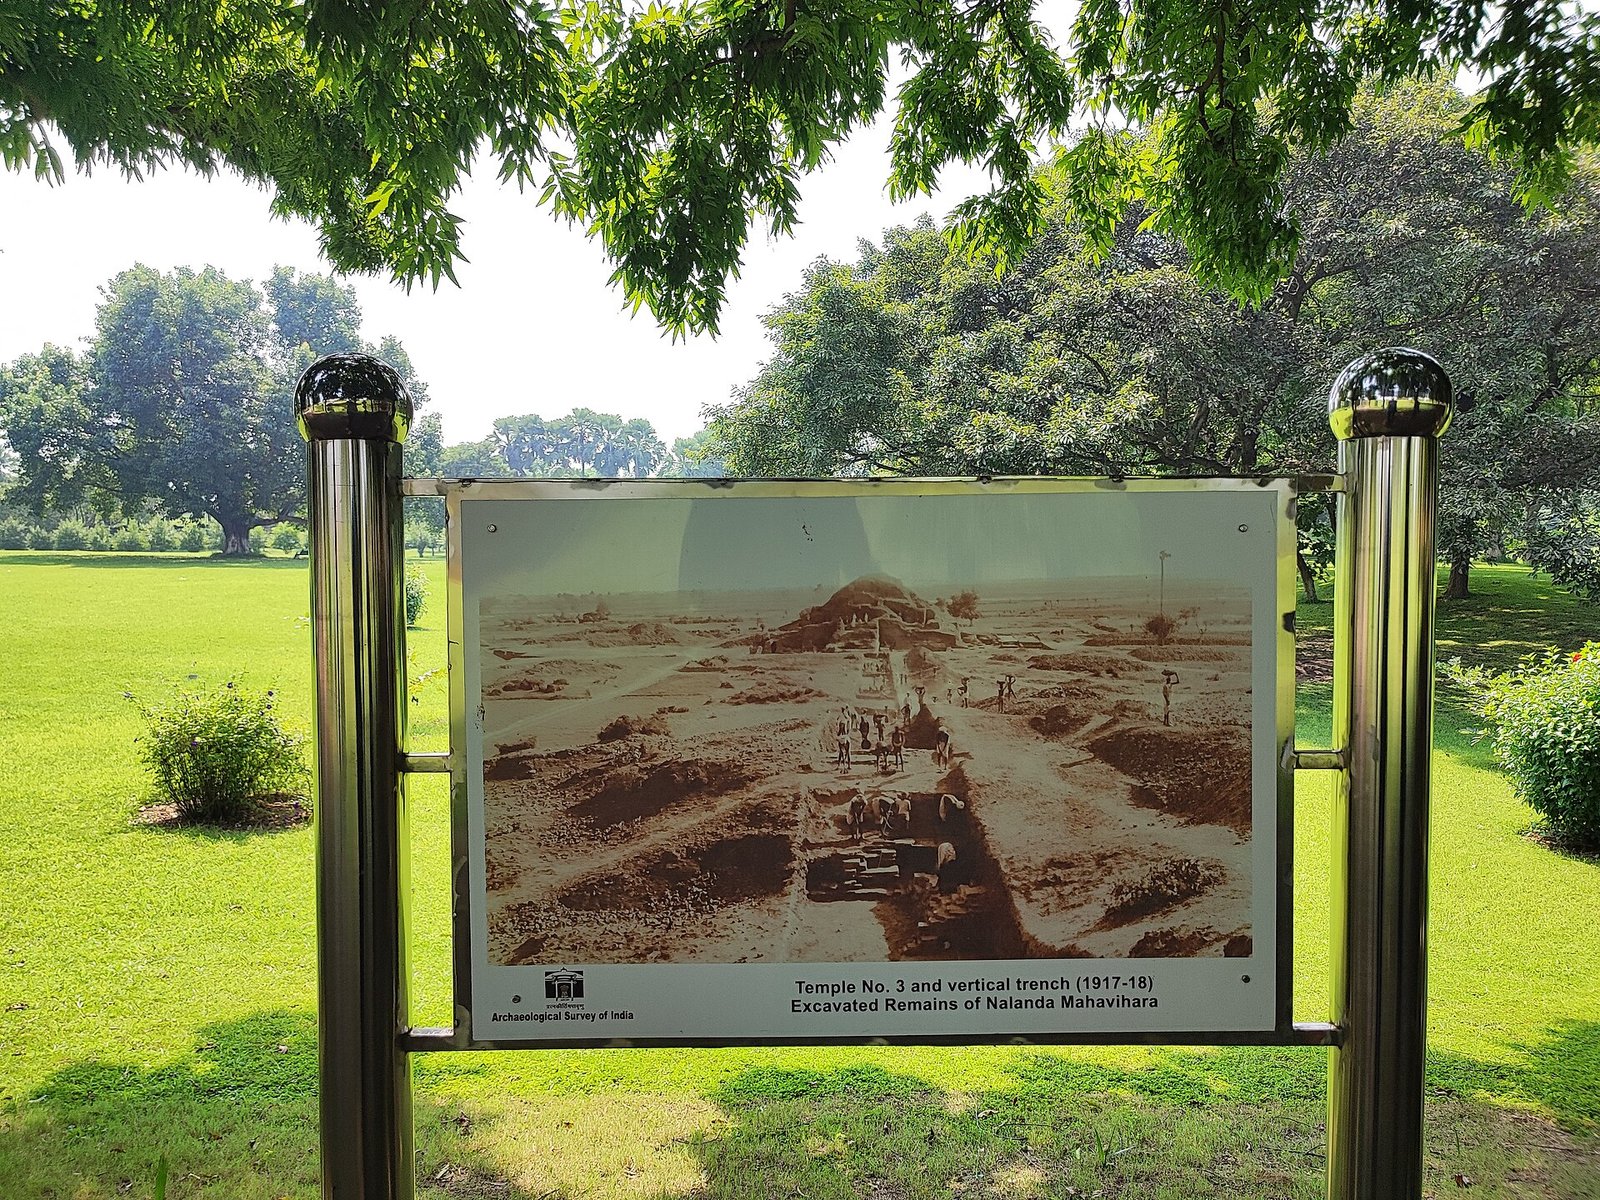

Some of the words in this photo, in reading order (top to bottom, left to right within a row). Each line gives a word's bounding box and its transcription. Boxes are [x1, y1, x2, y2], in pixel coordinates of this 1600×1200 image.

[795, 980, 856, 997] Temple
[862, 979, 890, 993] No.
[896, 979, 906, 993] 3
[911, 978, 942, 993] and
[948, 977, 1010, 992] vertical
[1016, 976, 1070, 991] trench
[1076, 975, 1154, 993] (1917-18)
[791, 998, 879, 1013] Excavated
[885, 997, 959, 1012] Remains
[964, 996, 982, 1011] of
[986, 995, 1055, 1010] Nalanda
[1061, 994, 1159, 1009] Mahavihara
[491, 1011, 562, 1023] Archaeological
[564, 1010, 597, 1023] Survey
[599, 1010, 608, 1020] of
[611, 1010, 634, 1020] India
